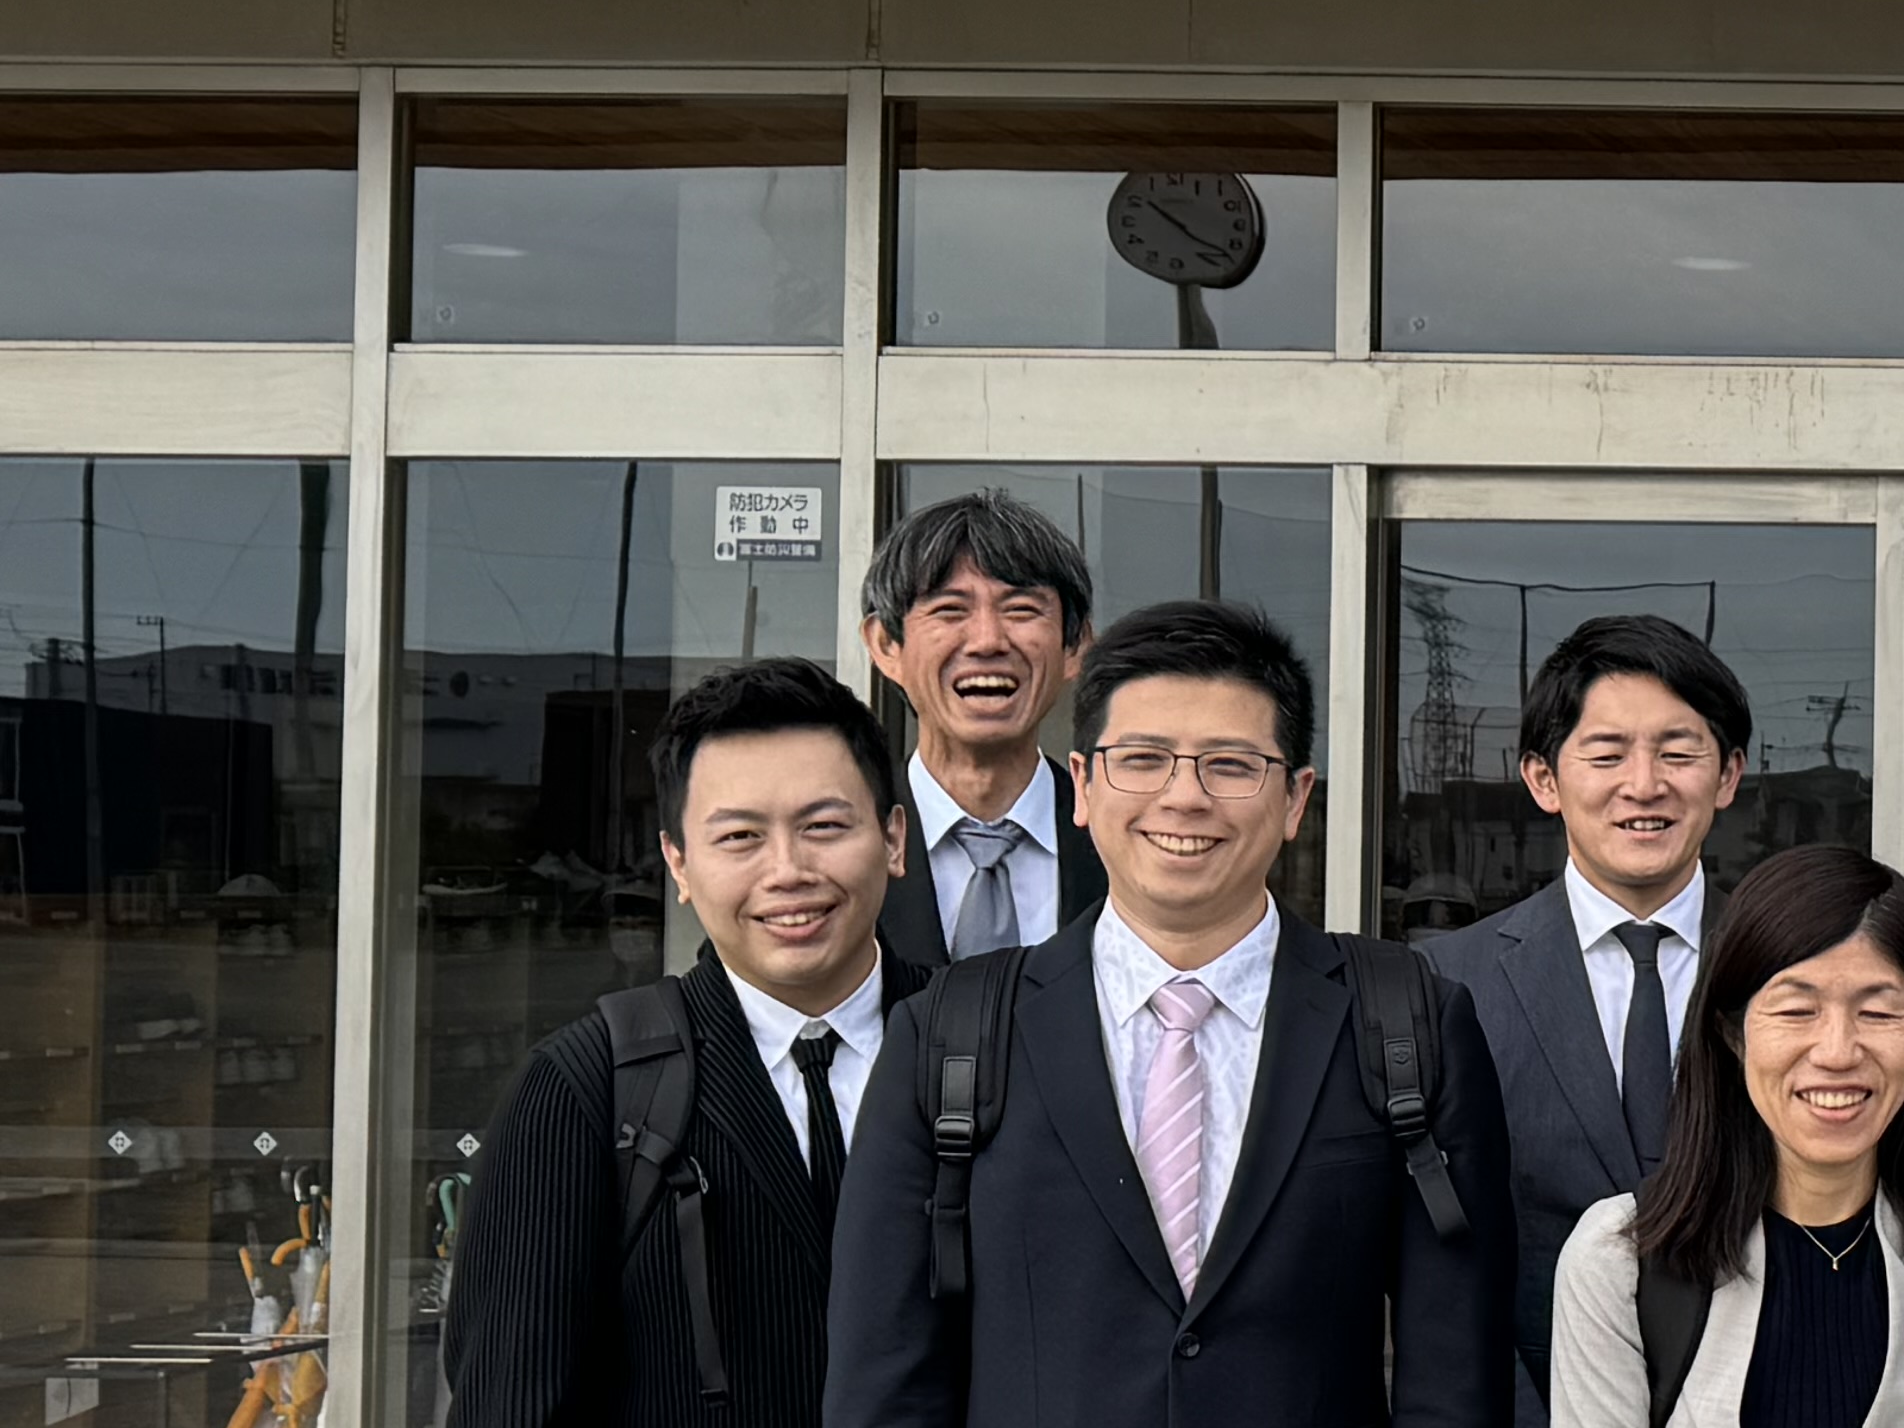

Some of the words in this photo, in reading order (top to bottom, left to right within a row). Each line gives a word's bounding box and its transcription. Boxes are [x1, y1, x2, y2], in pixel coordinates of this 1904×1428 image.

[729, 492, 808, 512] 防犯カメラ
